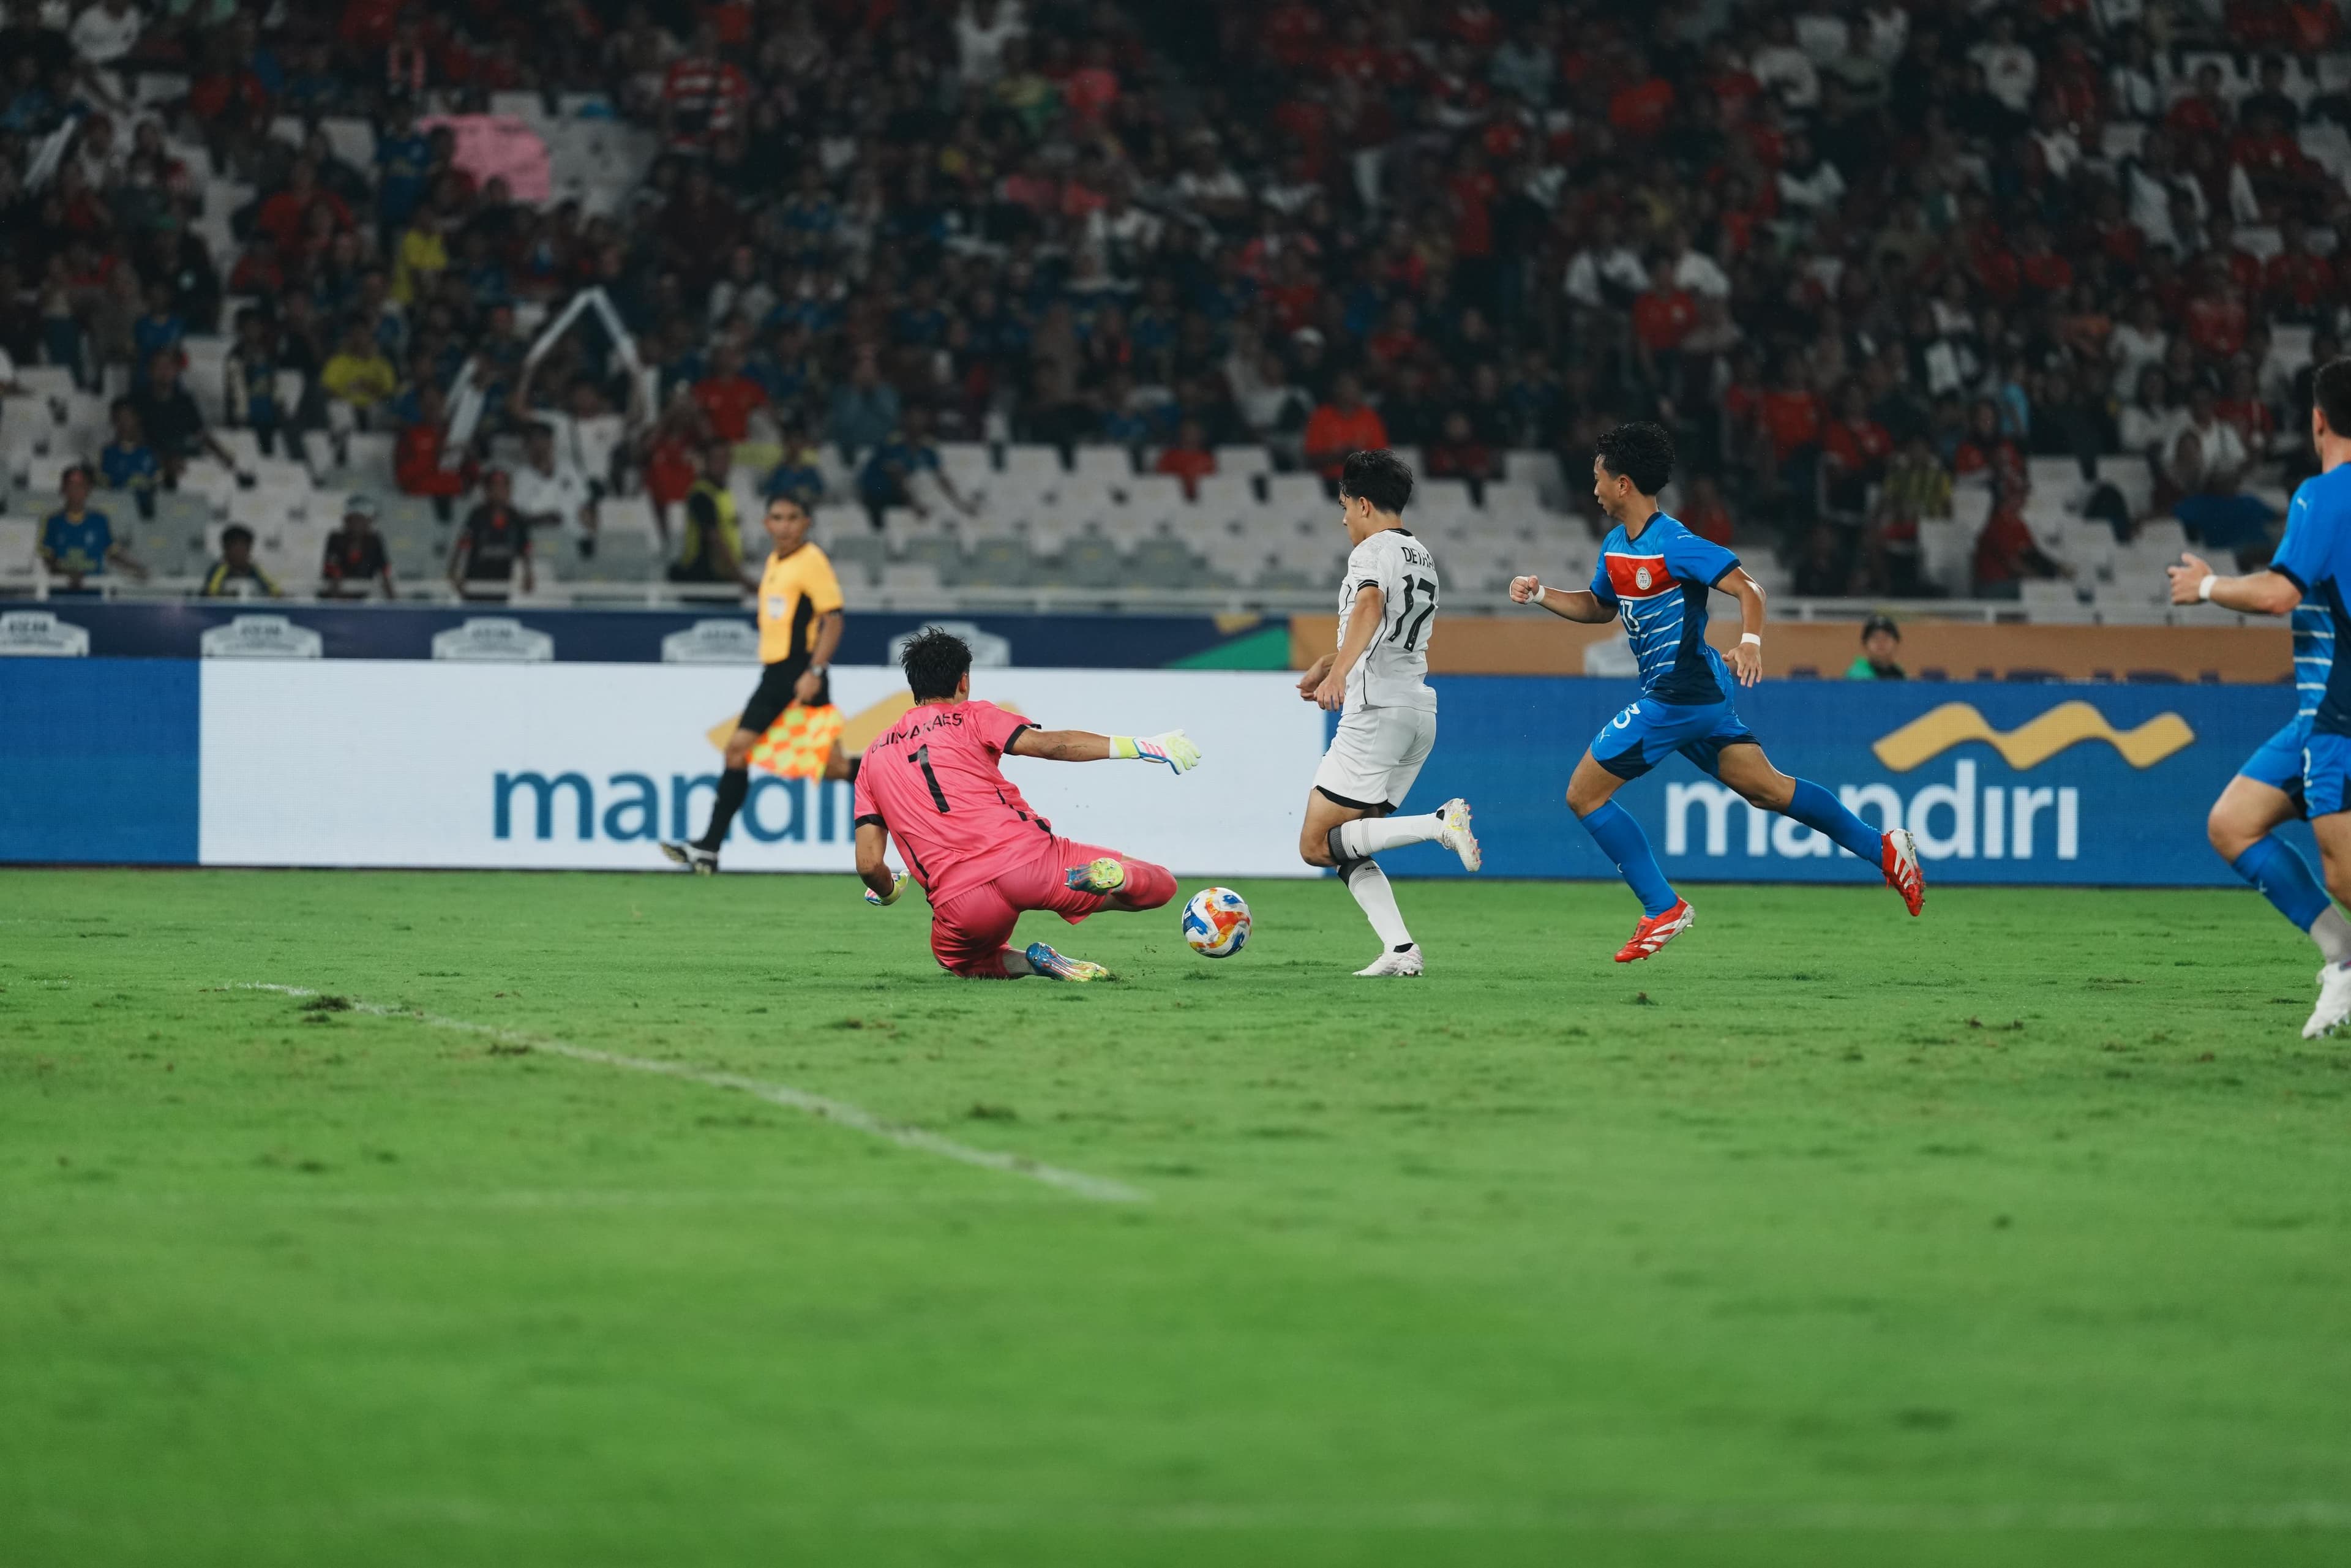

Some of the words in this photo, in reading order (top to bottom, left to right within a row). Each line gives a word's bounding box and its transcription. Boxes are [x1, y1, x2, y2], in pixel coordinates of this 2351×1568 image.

[1400, 546, 1436, 571] DETHA
[1388, 573, 1436, 653] 17
[871, 713, 962, 754] GUIMARAES
[907, 743, 951, 814] 1
[1665, 759, 2079, 860] mandiri
